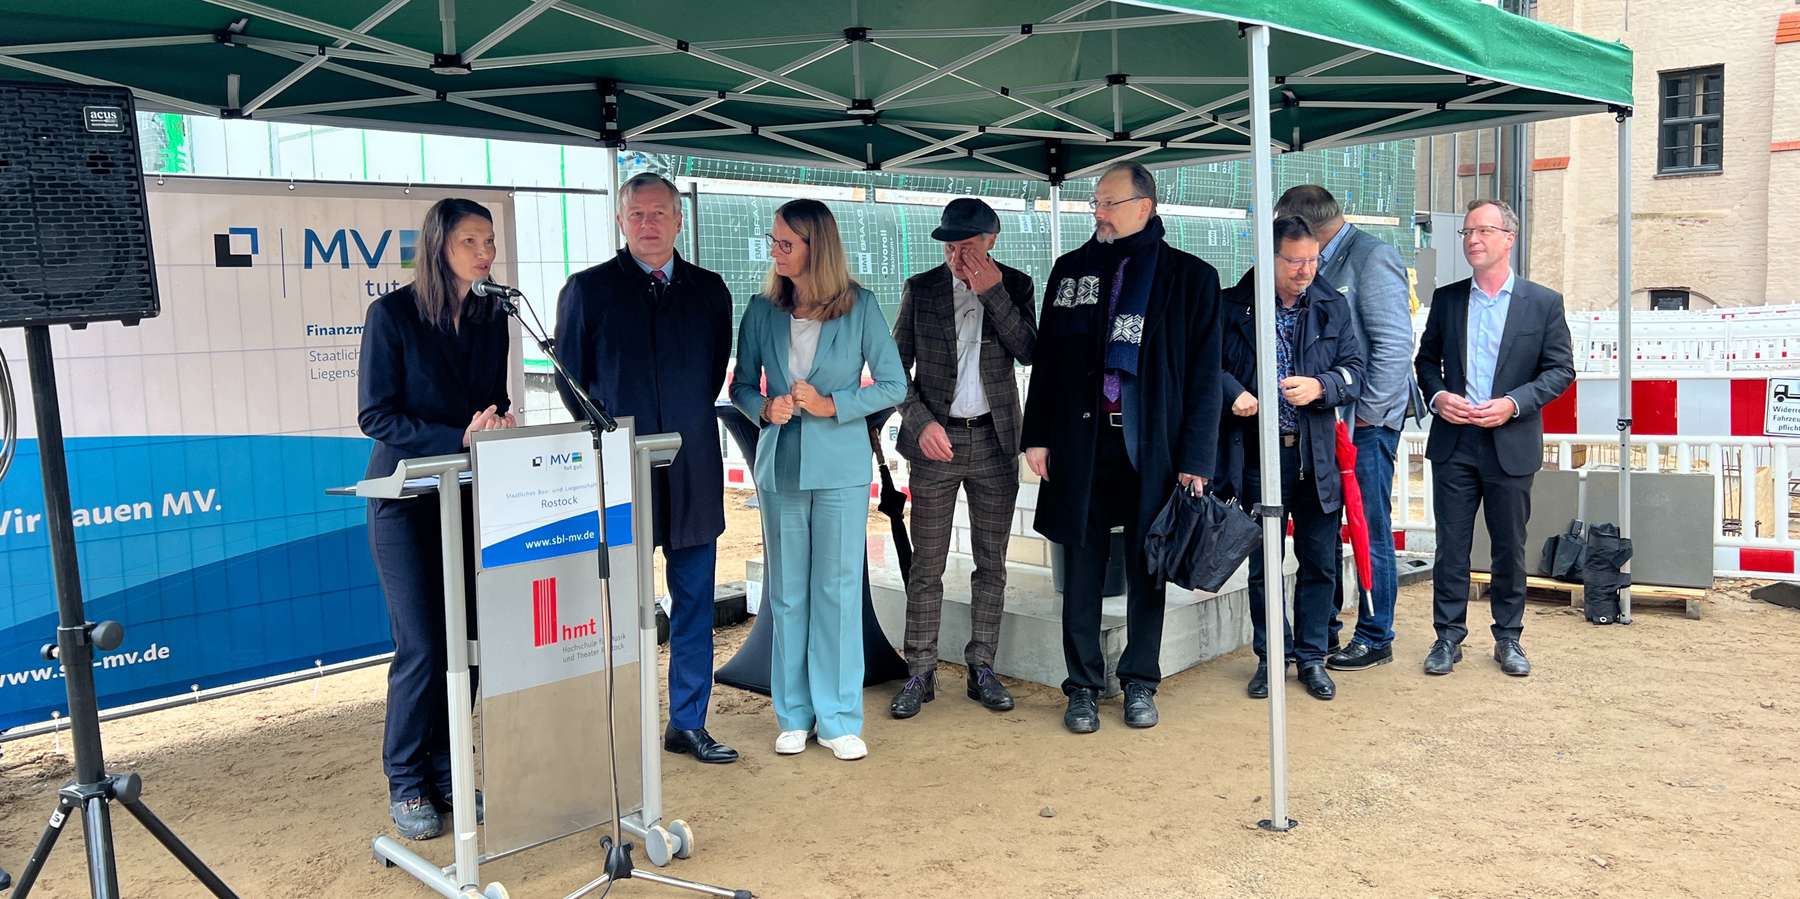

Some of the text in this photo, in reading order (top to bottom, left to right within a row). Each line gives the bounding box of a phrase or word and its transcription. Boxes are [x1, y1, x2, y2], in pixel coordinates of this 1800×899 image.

[90, 111, 117, 119] acus
[750, 198, 761, 236] BRAA
[857, 209, 867, 251] BRAAS
[304, 228, 392, 270] MV
[365, 279, 400, 297] tut
[550, 453, 570, 465] MV
[72, 500, 153, 527] auen
[162, 489, 222, 516] MV.
[541, 496, 578, 508] Rostock
[525, 530, 595, 549] www.sbl-mv.de
[562, 618, 596, 641] hmt
[562, 641, 597, 654] Hochschule
[0, 643, 170, 688] ww.s-mv.de
[562, 654, 575, 663] und
